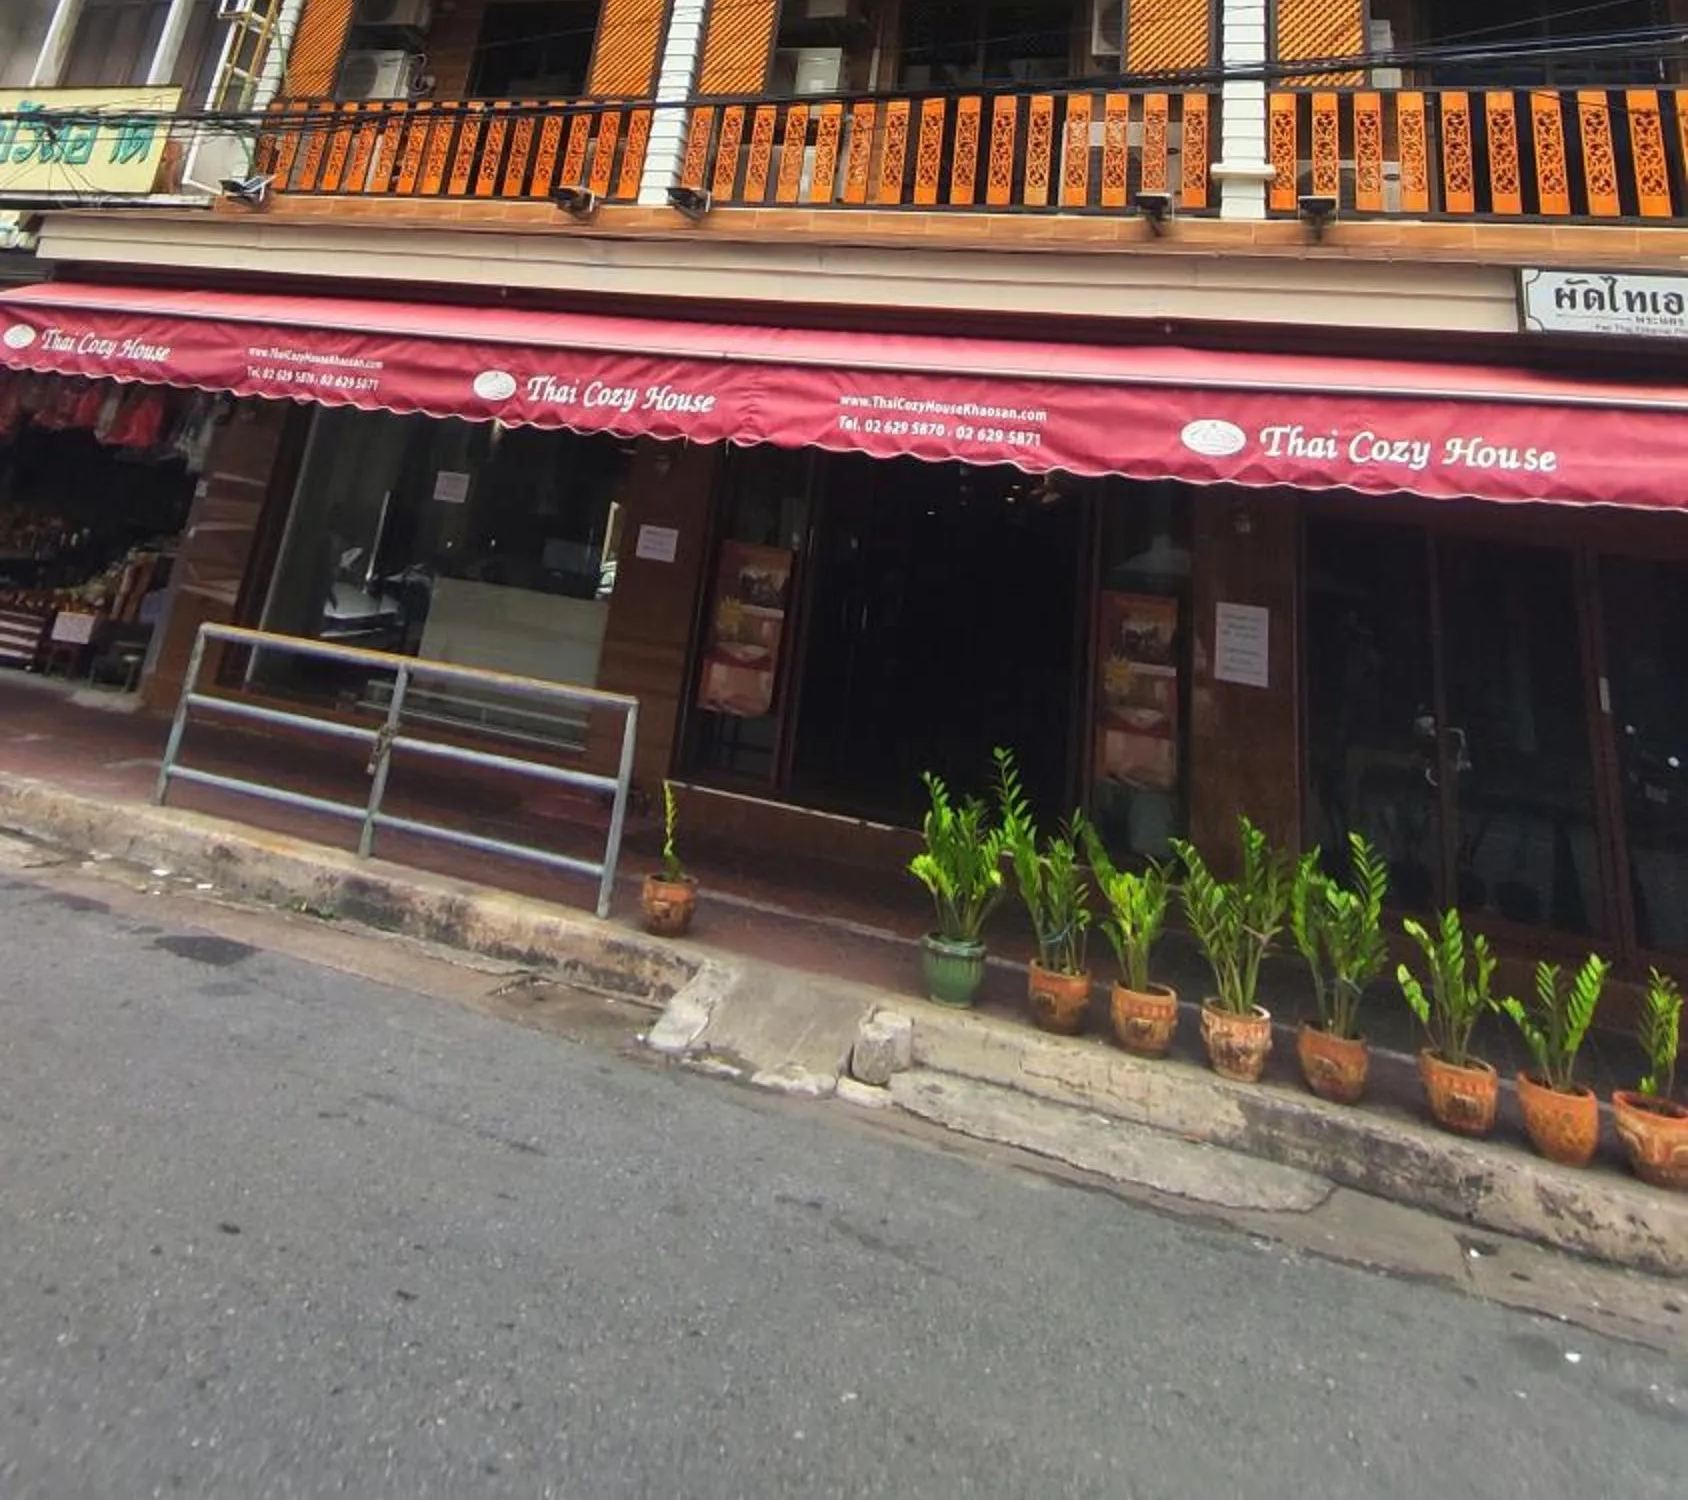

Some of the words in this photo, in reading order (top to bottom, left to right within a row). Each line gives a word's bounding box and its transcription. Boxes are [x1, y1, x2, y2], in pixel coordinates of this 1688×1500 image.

[42, 328, 75, 351] Thai
[77, 331, 117, 359] Cozy
[117, 337, 171, 362] House
[527, 375, 579, 402] Thai
[583, 381, 638, 412] Cozy
[642, 386, 716, 413] House
[839, 415, 861, 432] Tel.
[864, 419, 881, 433] 02
[883, 420, 909, 435] 629
[955, 424, 974, 440] 02
[977, 428, 1004, 443] 629
[1007, 430, 1041, 447] 5871
[1259, 425, 1338, 459] Thai
[1348, 431, 1431, 470] Cozy
[1442, 437, 1557, 472] House
